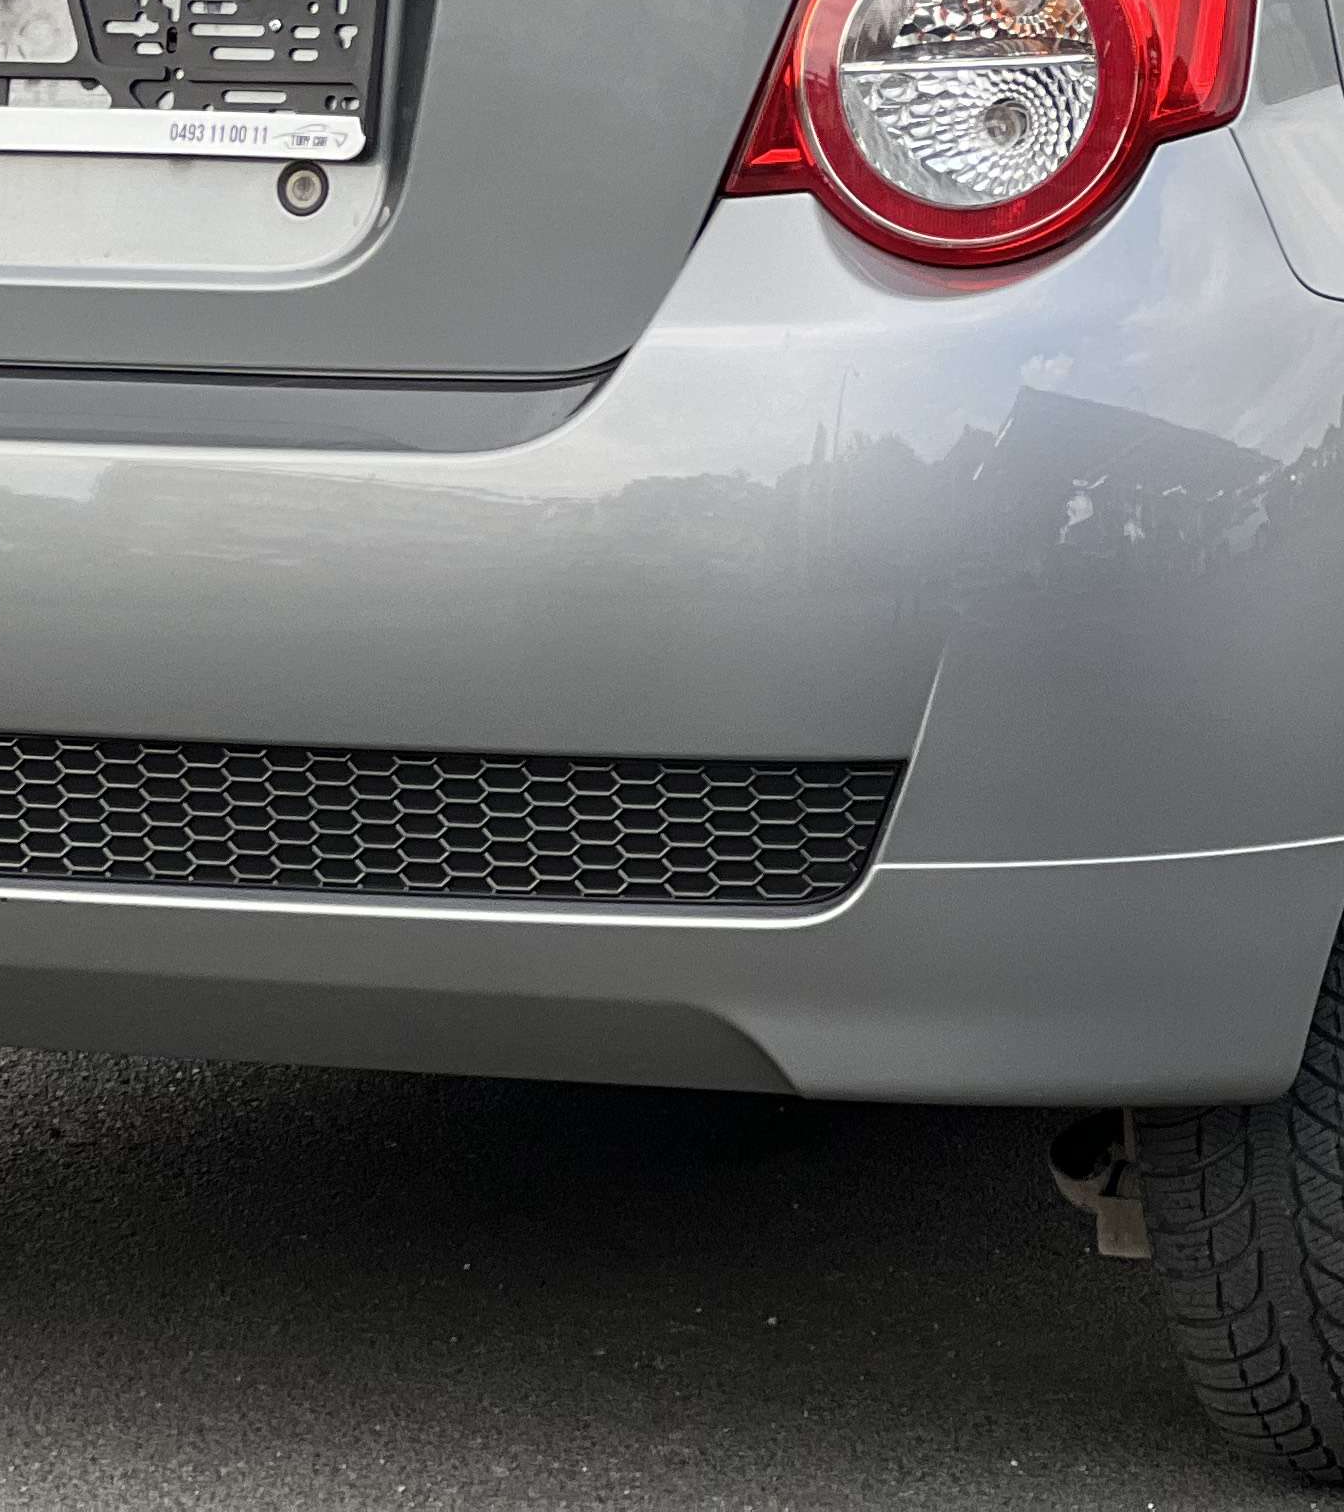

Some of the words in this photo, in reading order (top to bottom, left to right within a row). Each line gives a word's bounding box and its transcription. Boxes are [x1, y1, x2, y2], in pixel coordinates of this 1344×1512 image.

[169, 123, 205, 142] 0493
[210, 124, 225, 143] 11
[229, 125, 248, 143] 00
[253, 125, 268, 144] 11
